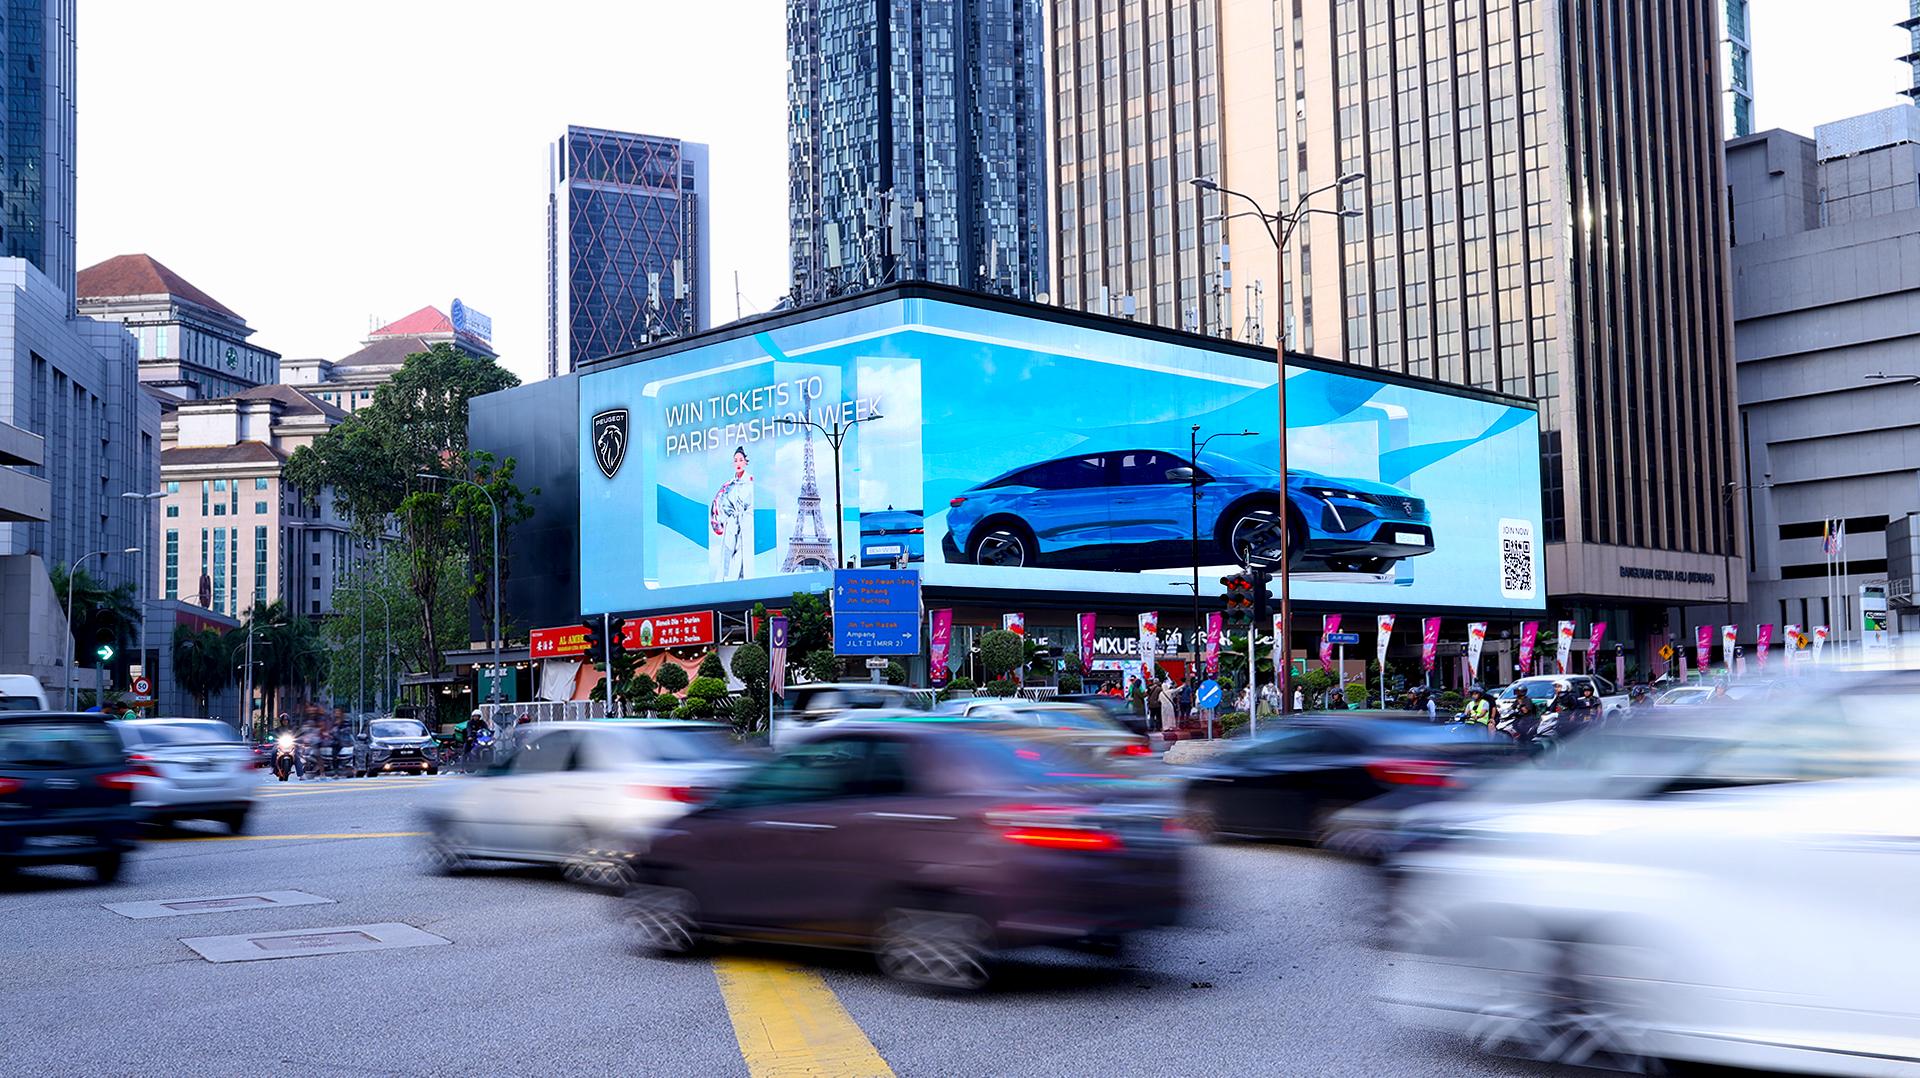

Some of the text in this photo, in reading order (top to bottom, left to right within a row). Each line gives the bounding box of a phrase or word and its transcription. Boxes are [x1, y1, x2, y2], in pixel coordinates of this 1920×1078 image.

[665, 376, 823, 428] WIN TICKETS TO
[595, 415, 625, 426] PEUGEOT
[666, 395, 883, 457] PARIS FASHION WEEK
[1515, 527, 1529, 536] NOW
[846, 631, 876, 639] Ampang
[1092, 637, 1137, 655] MIXUE
[138, 681, 147, 690] 50
